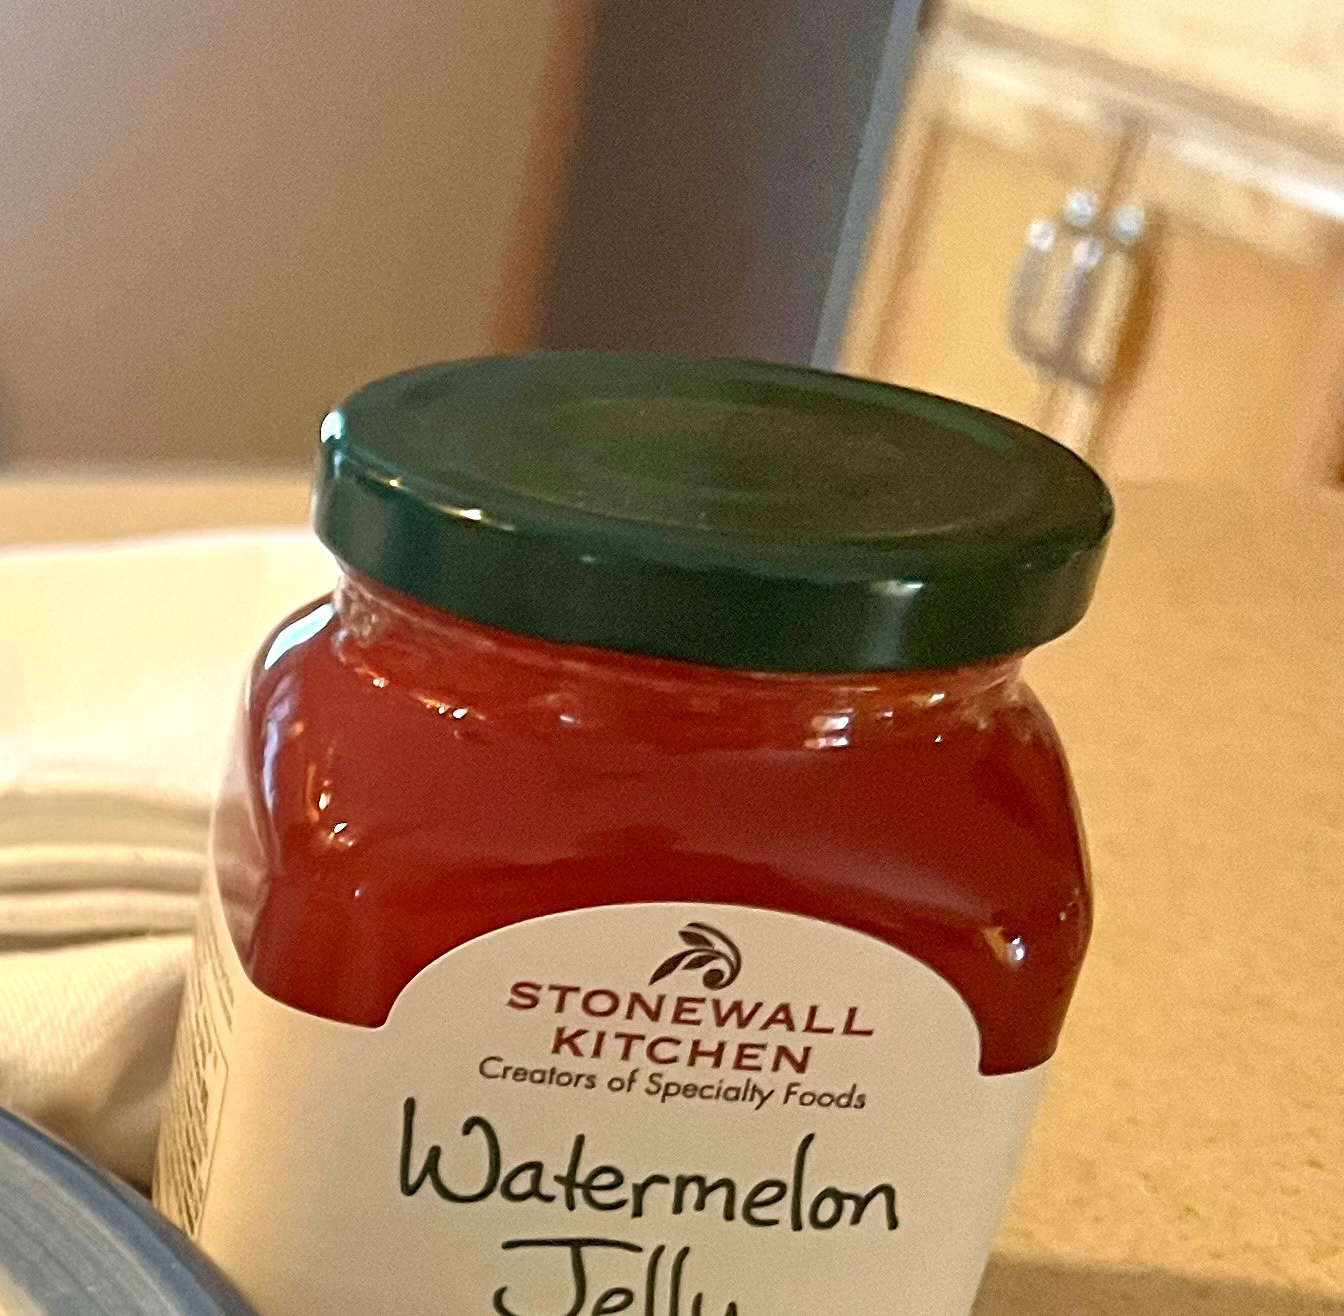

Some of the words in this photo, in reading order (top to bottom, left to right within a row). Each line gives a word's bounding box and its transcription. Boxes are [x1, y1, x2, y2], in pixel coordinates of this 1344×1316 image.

[506, 981, 874, 1038] STONEWALL
[550, 1026, 812, 1075] KITCHEN
[478, 1056, 597, 1090] Creators
[607, 1068, 641, 1094] of
[645, 1072, 775, 1110] Specialty
[783, 1082, 868, 1110] Foods
[399, 1096, 899, 1232] Watermelon
